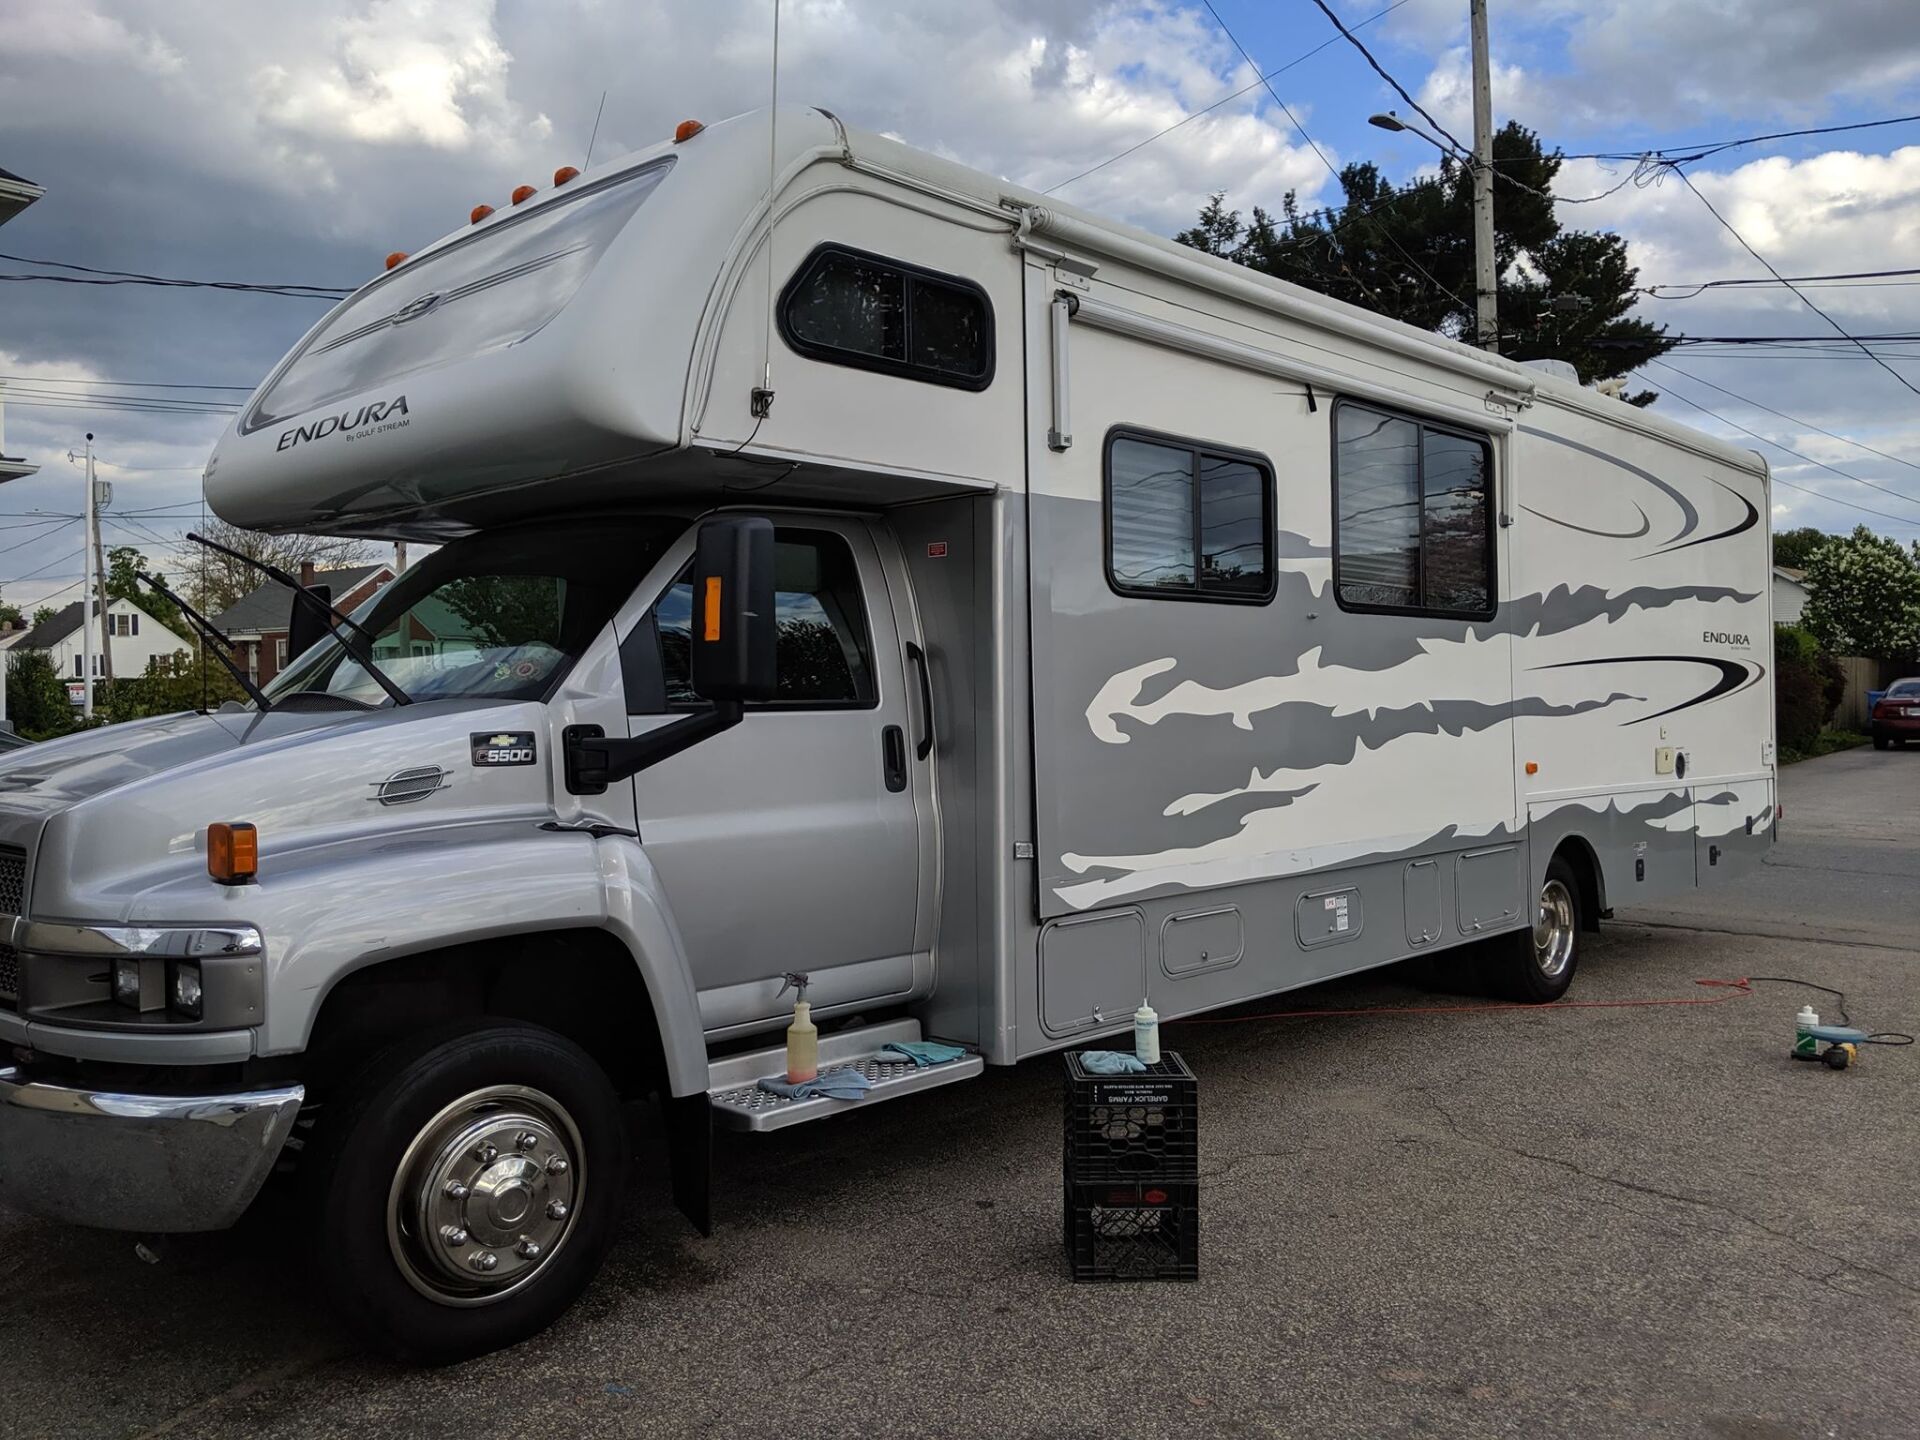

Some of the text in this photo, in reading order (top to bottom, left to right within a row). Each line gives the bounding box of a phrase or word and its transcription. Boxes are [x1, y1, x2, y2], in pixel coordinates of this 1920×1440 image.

[276, 395, 409, 452] ENDURA
[346, 419, 410, 442] By GULF STREAM
[1703, 631, 1750, 645] ENDURA
[476, 749, 533, 763] C5500
